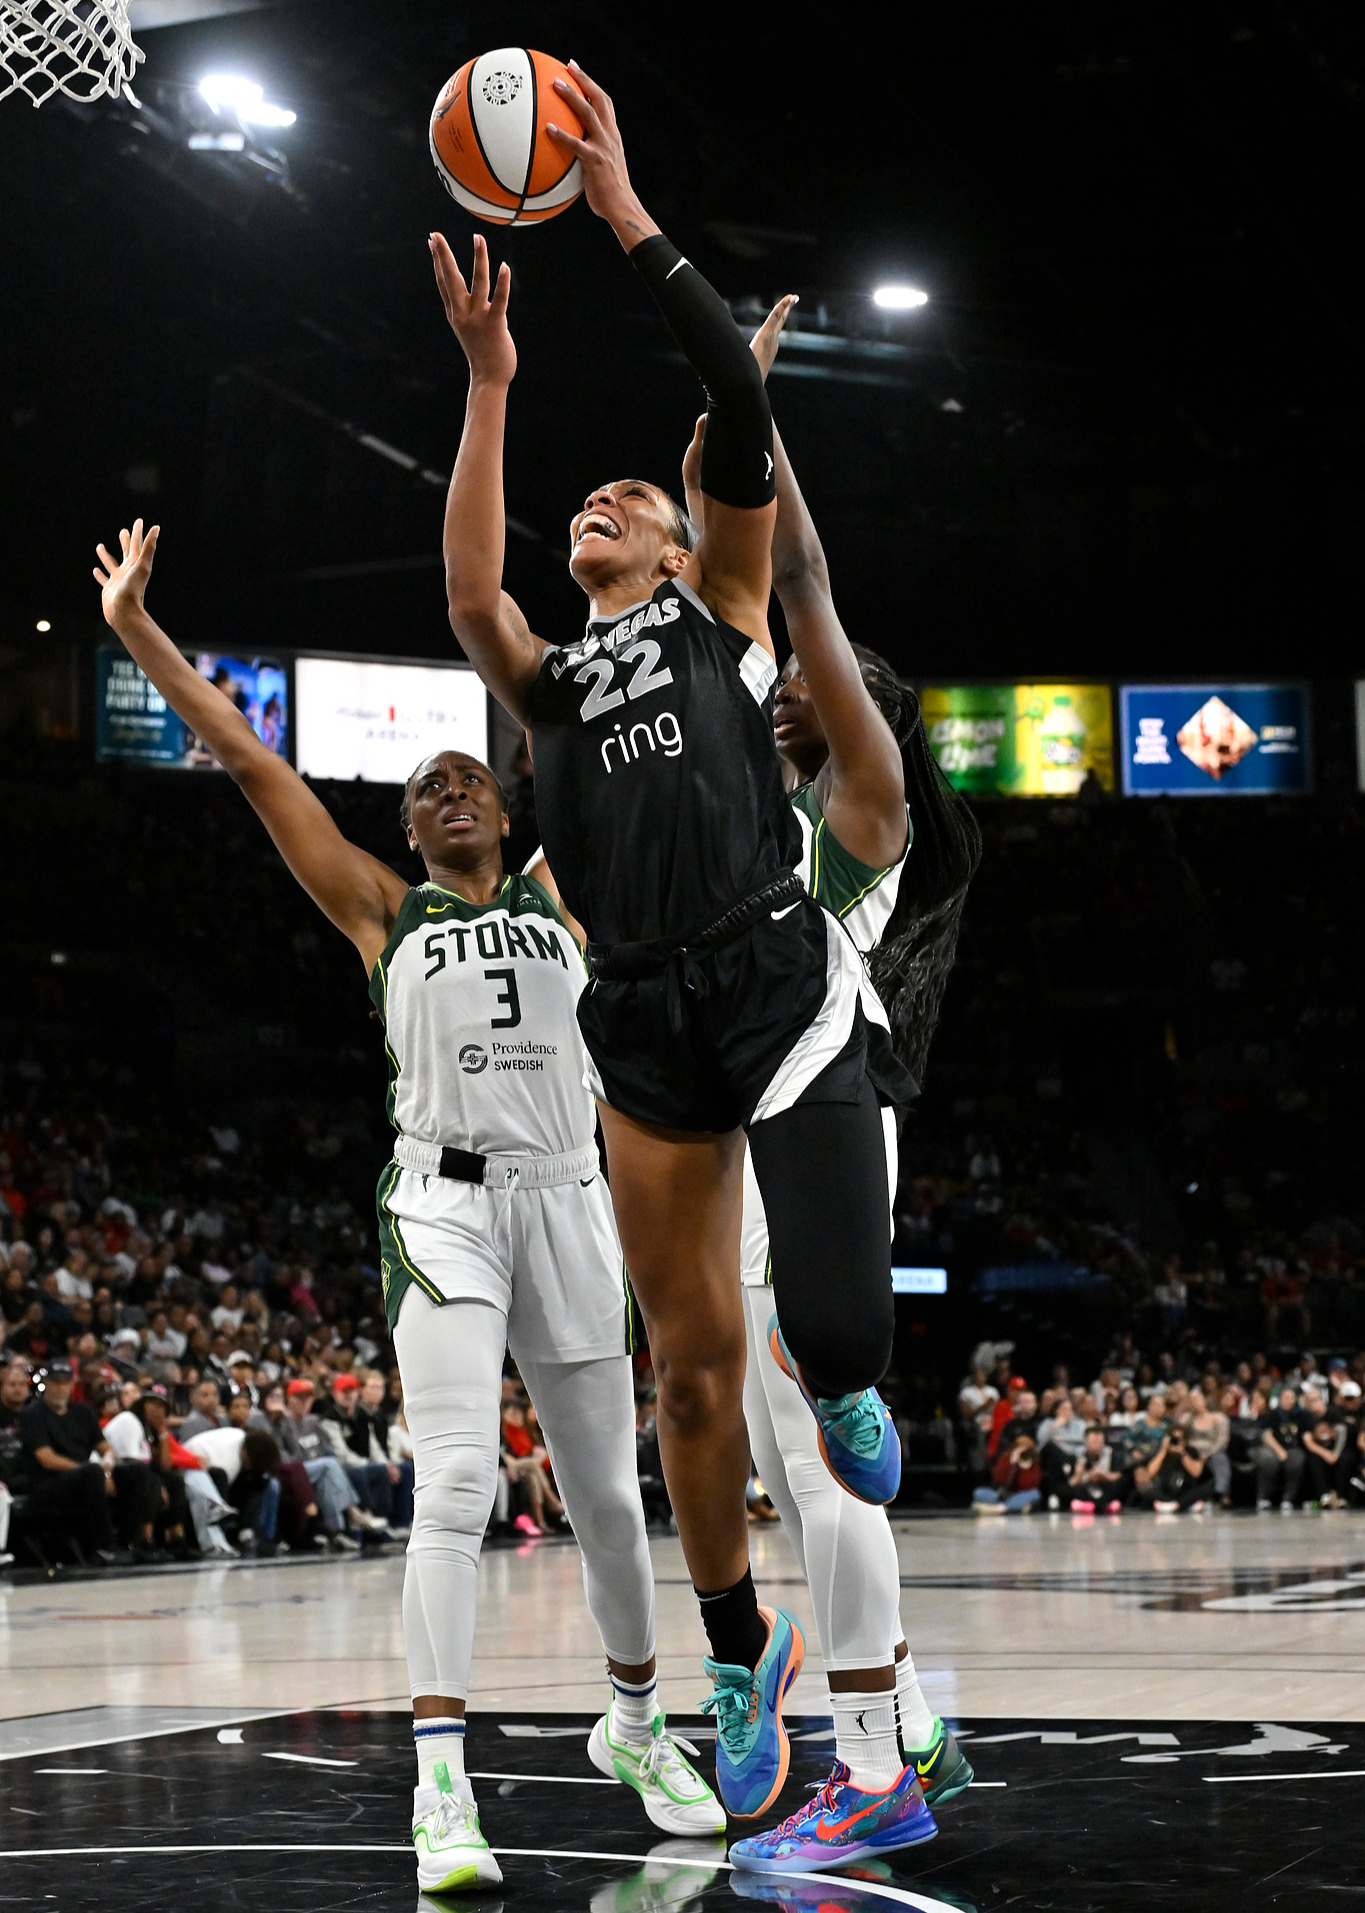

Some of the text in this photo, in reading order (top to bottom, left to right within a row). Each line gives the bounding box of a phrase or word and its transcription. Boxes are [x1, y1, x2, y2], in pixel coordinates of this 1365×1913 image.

[601, 598, 681, 652] VEGAS
[573, 639, 674, 722] 22
[601, 712, 683, 773] ring
[424, 917, 569, 981] STORM
[483, 968, 522, 1029] 3
[491, 1040, 558, 1056] Providence
[494, 1058, 544, 1072] SWEDISH
